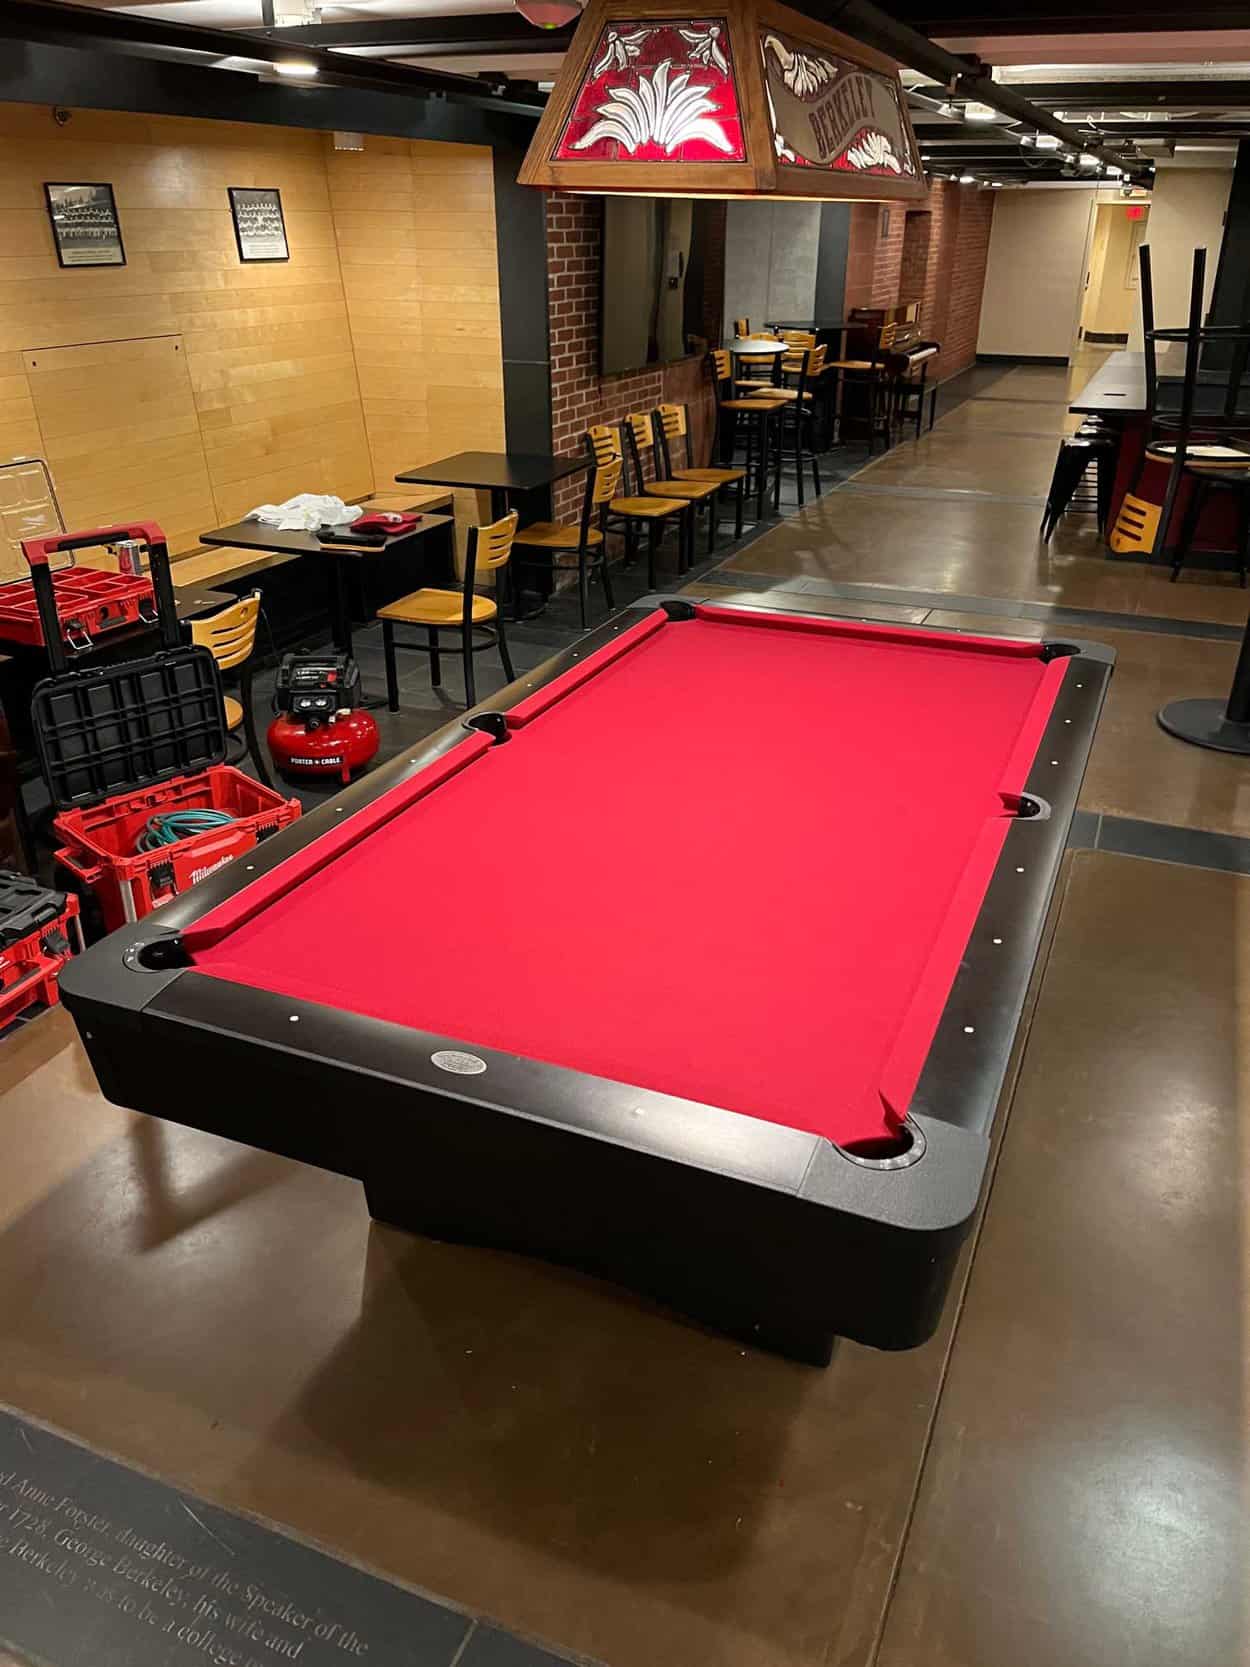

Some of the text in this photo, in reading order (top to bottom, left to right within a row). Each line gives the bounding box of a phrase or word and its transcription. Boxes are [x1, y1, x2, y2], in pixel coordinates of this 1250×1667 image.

[54, 1528, 106, 1567] George
[192, 1594, 219, 1619] his
[224, 1612, 265, 1641] wife
[264, 1636, 304, 1659] and
[115, 1527, 184, 1569] daughter
[211, 1571, 240, 1595] the
[241, 1583, 314, 1629] Speaker
[314, 1622, 343, 1641] of
[337, 1631, 369, 1656] the
[138, 1598, 159, 1625] be
[177, 1625, 243, 1666] college
